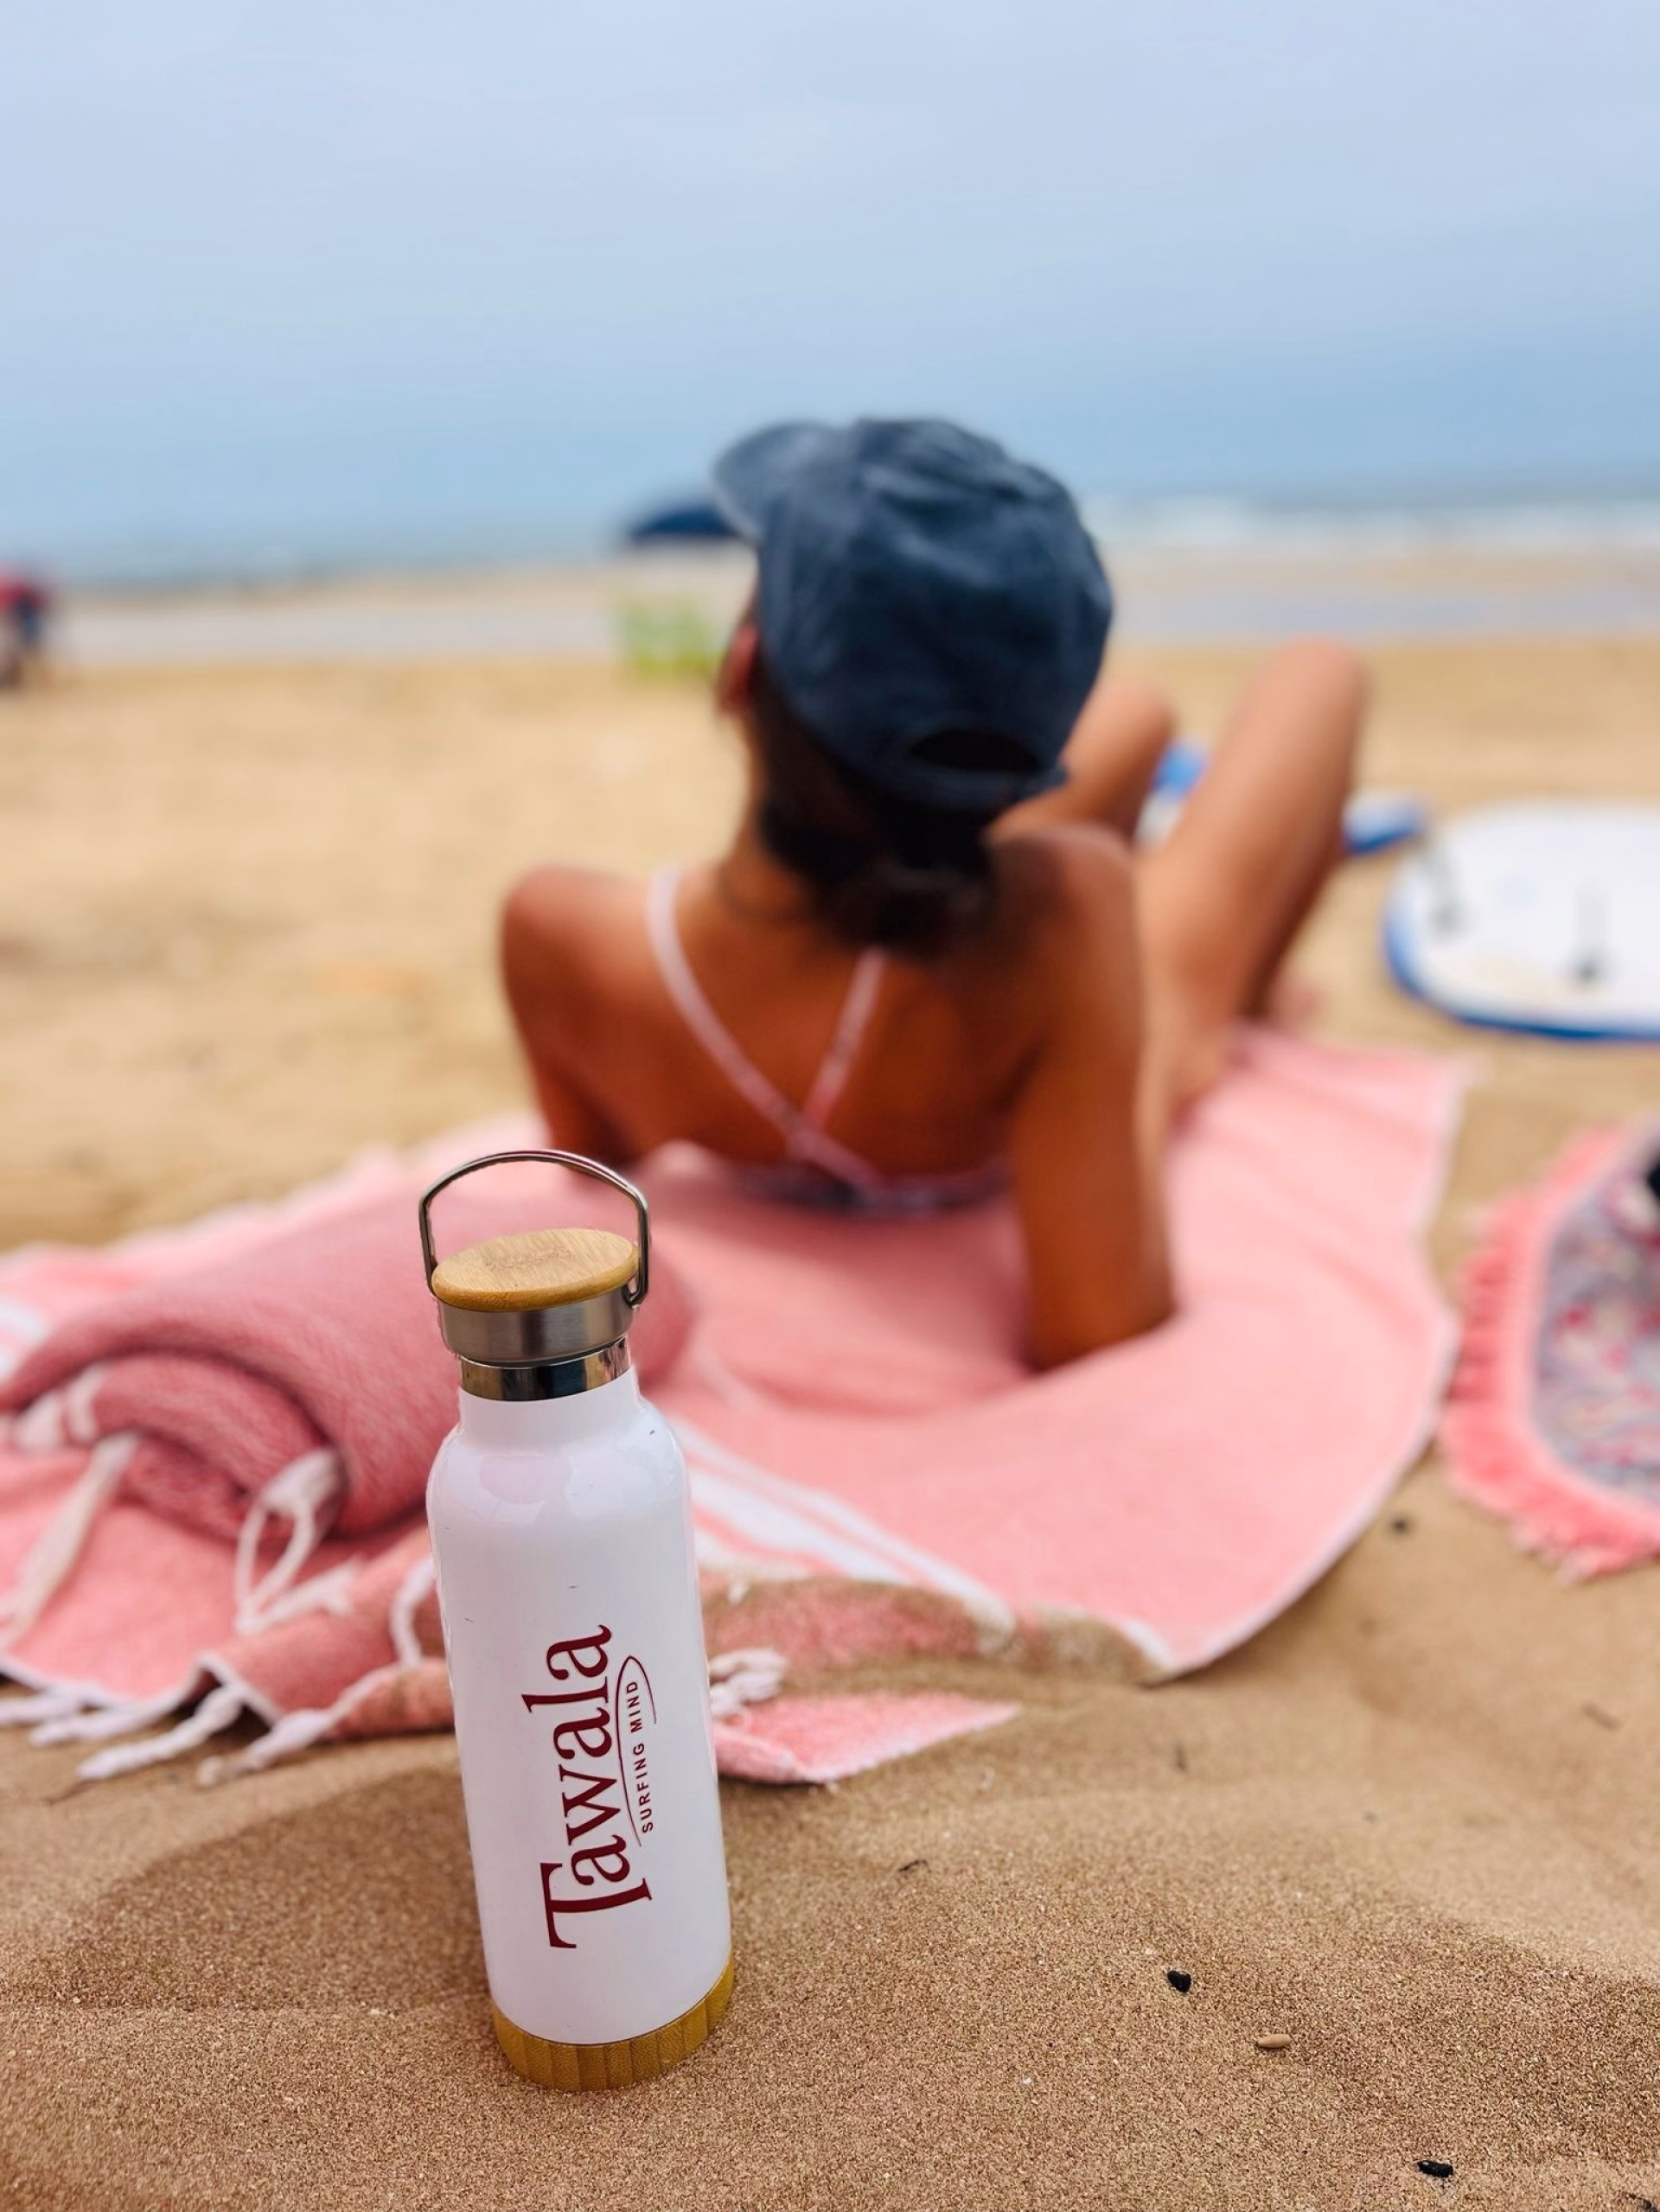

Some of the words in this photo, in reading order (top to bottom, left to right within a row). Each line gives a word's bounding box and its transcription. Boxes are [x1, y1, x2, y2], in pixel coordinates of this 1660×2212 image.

[626, 1681, 642, 1733] MIND
[521, 1624, 653, 1949] Tawala
[633, 1743, 654, 1833] SURFING
